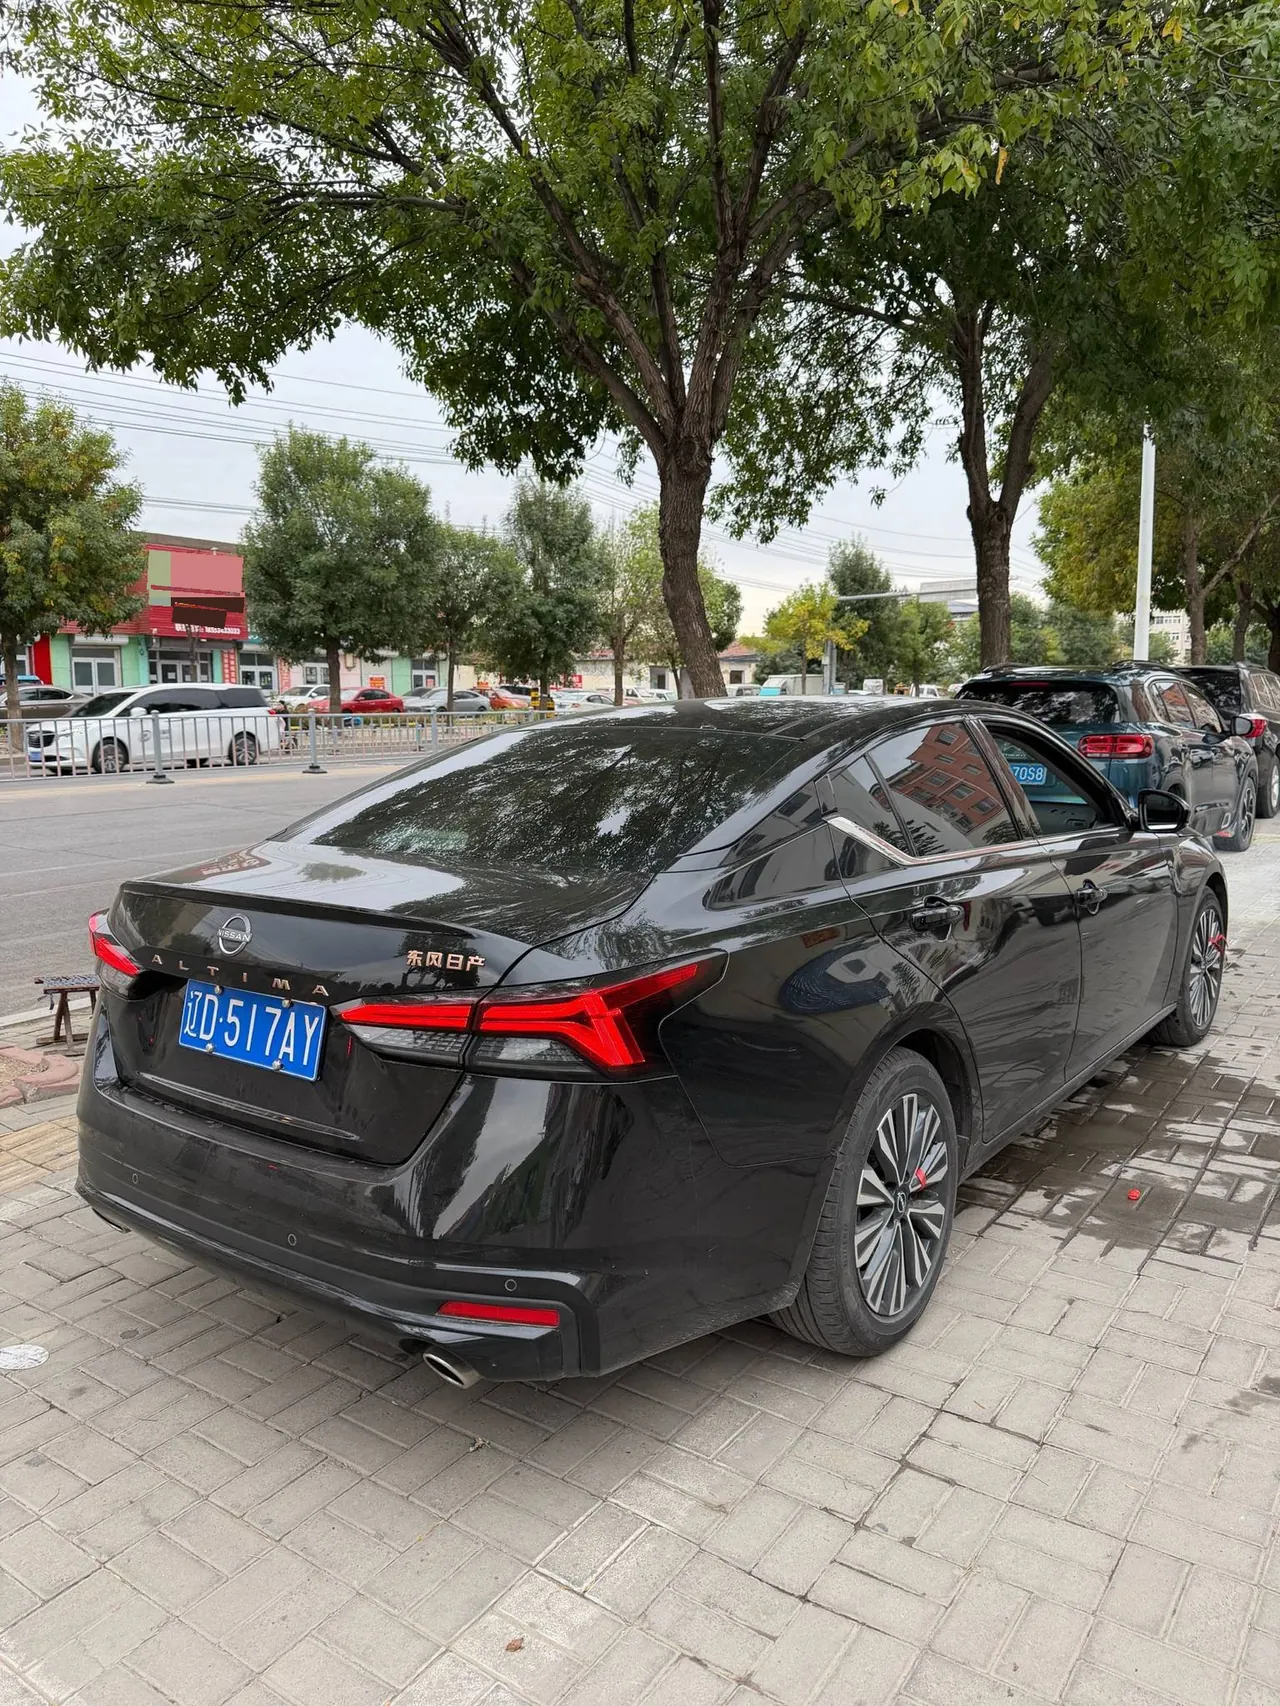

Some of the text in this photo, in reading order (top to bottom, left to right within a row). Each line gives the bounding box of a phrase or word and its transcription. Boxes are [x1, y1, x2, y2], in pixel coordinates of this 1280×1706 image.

[1013, 767, 1044, 781] 70S8
[217, 929, 252, 942] NISSAN
[406, 950, 486, 972] 东风日产
[151, 954, 330, 997] ALTIMA
